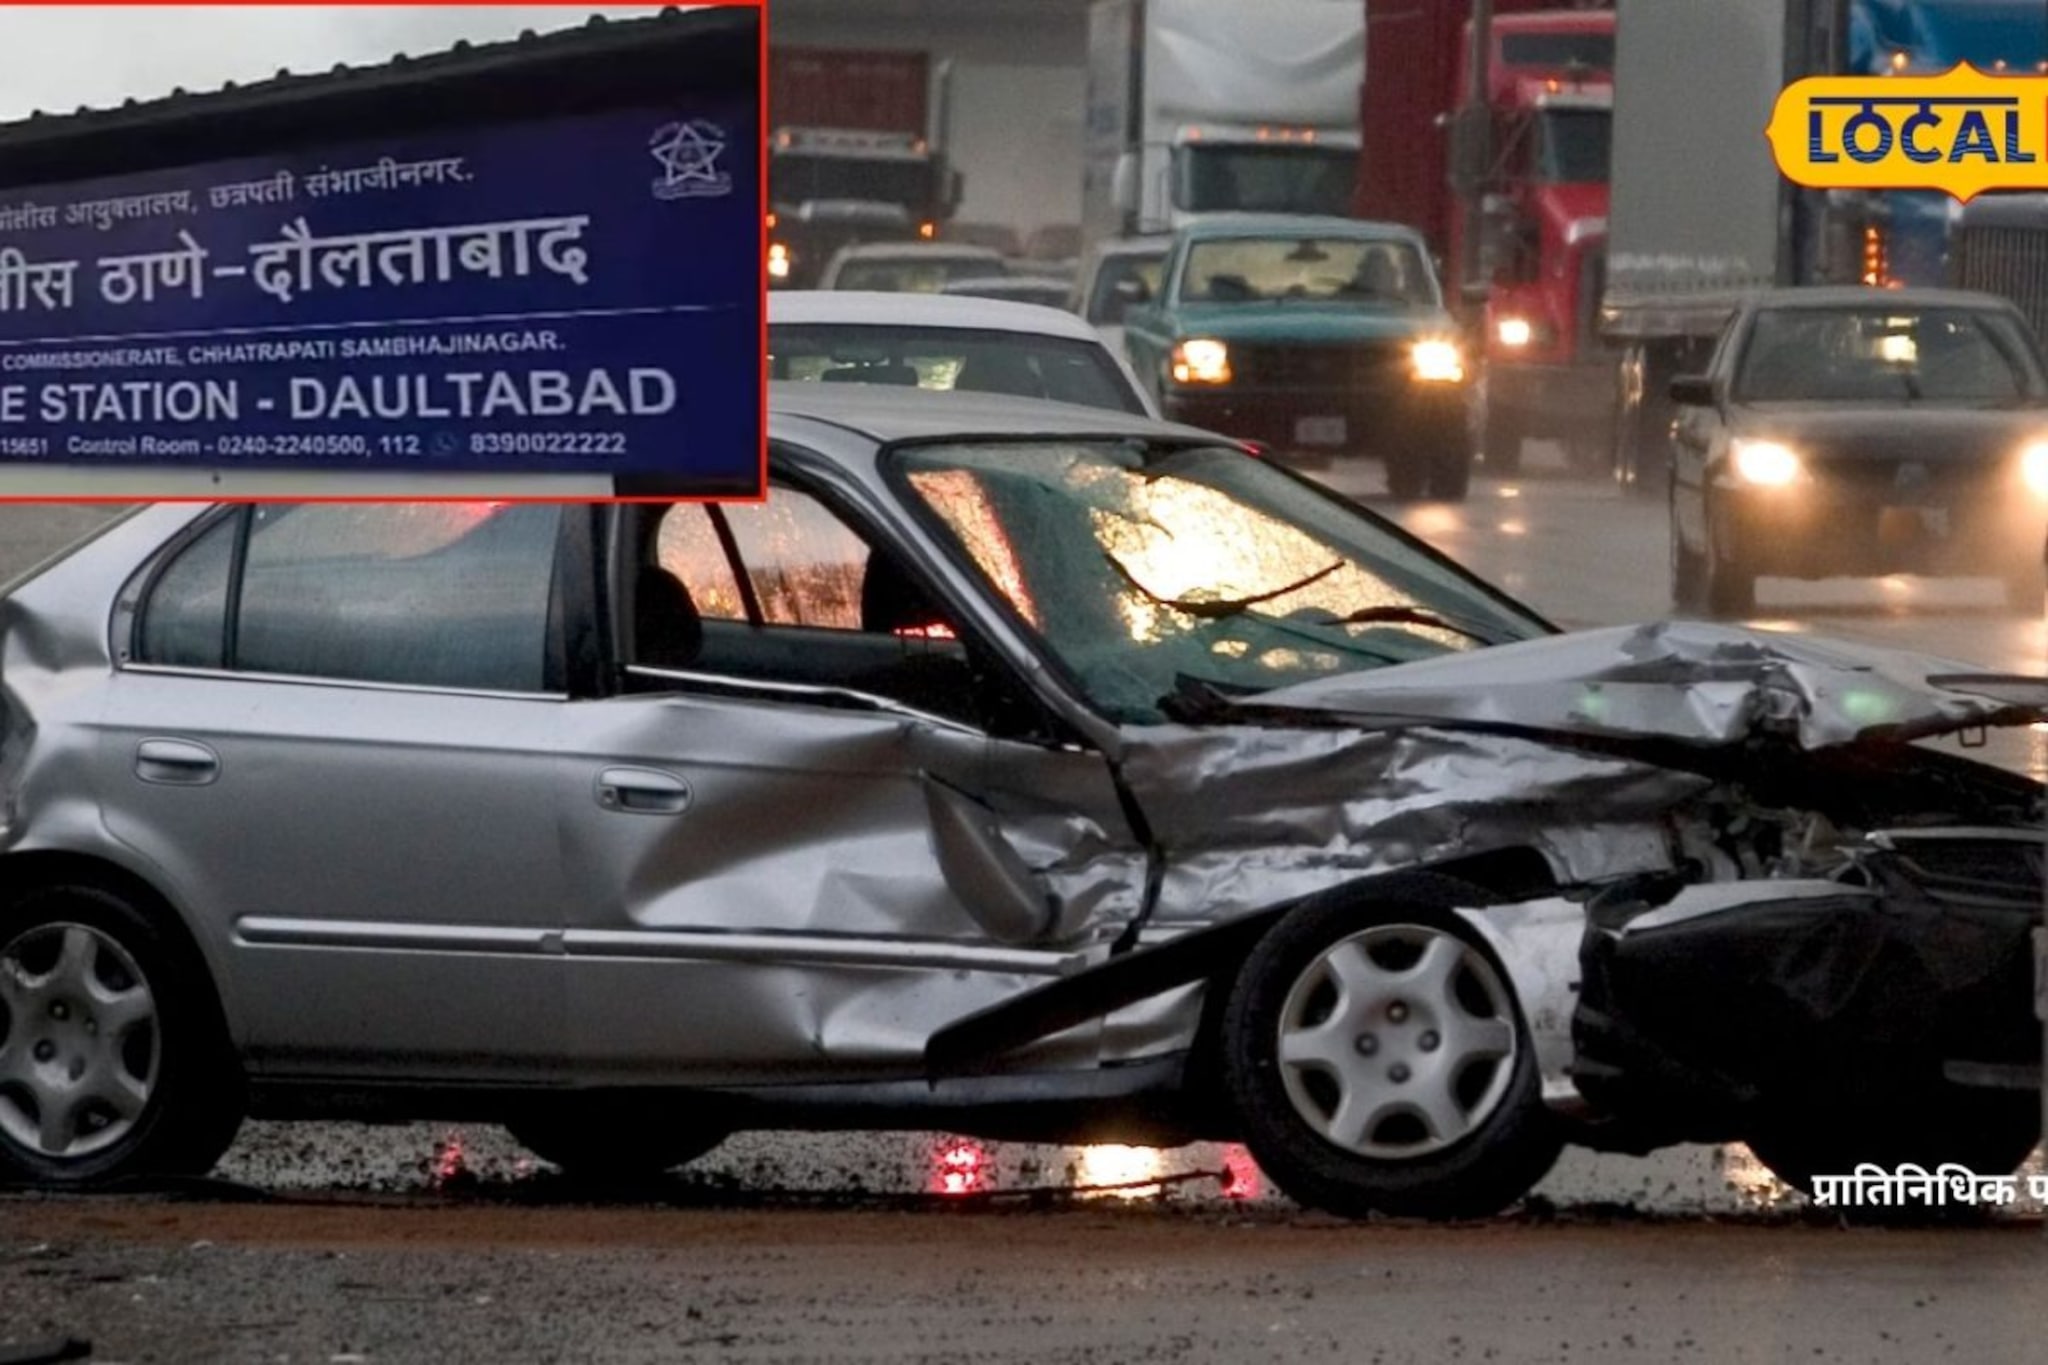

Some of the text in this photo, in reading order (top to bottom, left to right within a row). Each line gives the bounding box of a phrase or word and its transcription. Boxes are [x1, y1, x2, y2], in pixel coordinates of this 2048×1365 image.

[209, 170, 294, 208] छत्रपती
[305, 157, 474, 198] संभाजीनगर.
[2, 331, 566, 371] COMMISSIONERATE, CHHATRAPATI SAMBHAJINAGAR.
[40, 380, 239, 421] STATION
[290, 368, 676, 420] DAULTABAD
[67, 436, 137, 454] Control
[141, 436, 199, 454] Room
[379, 436, 421, 455] 112
[470, 432, 627, 454] 8390022222
